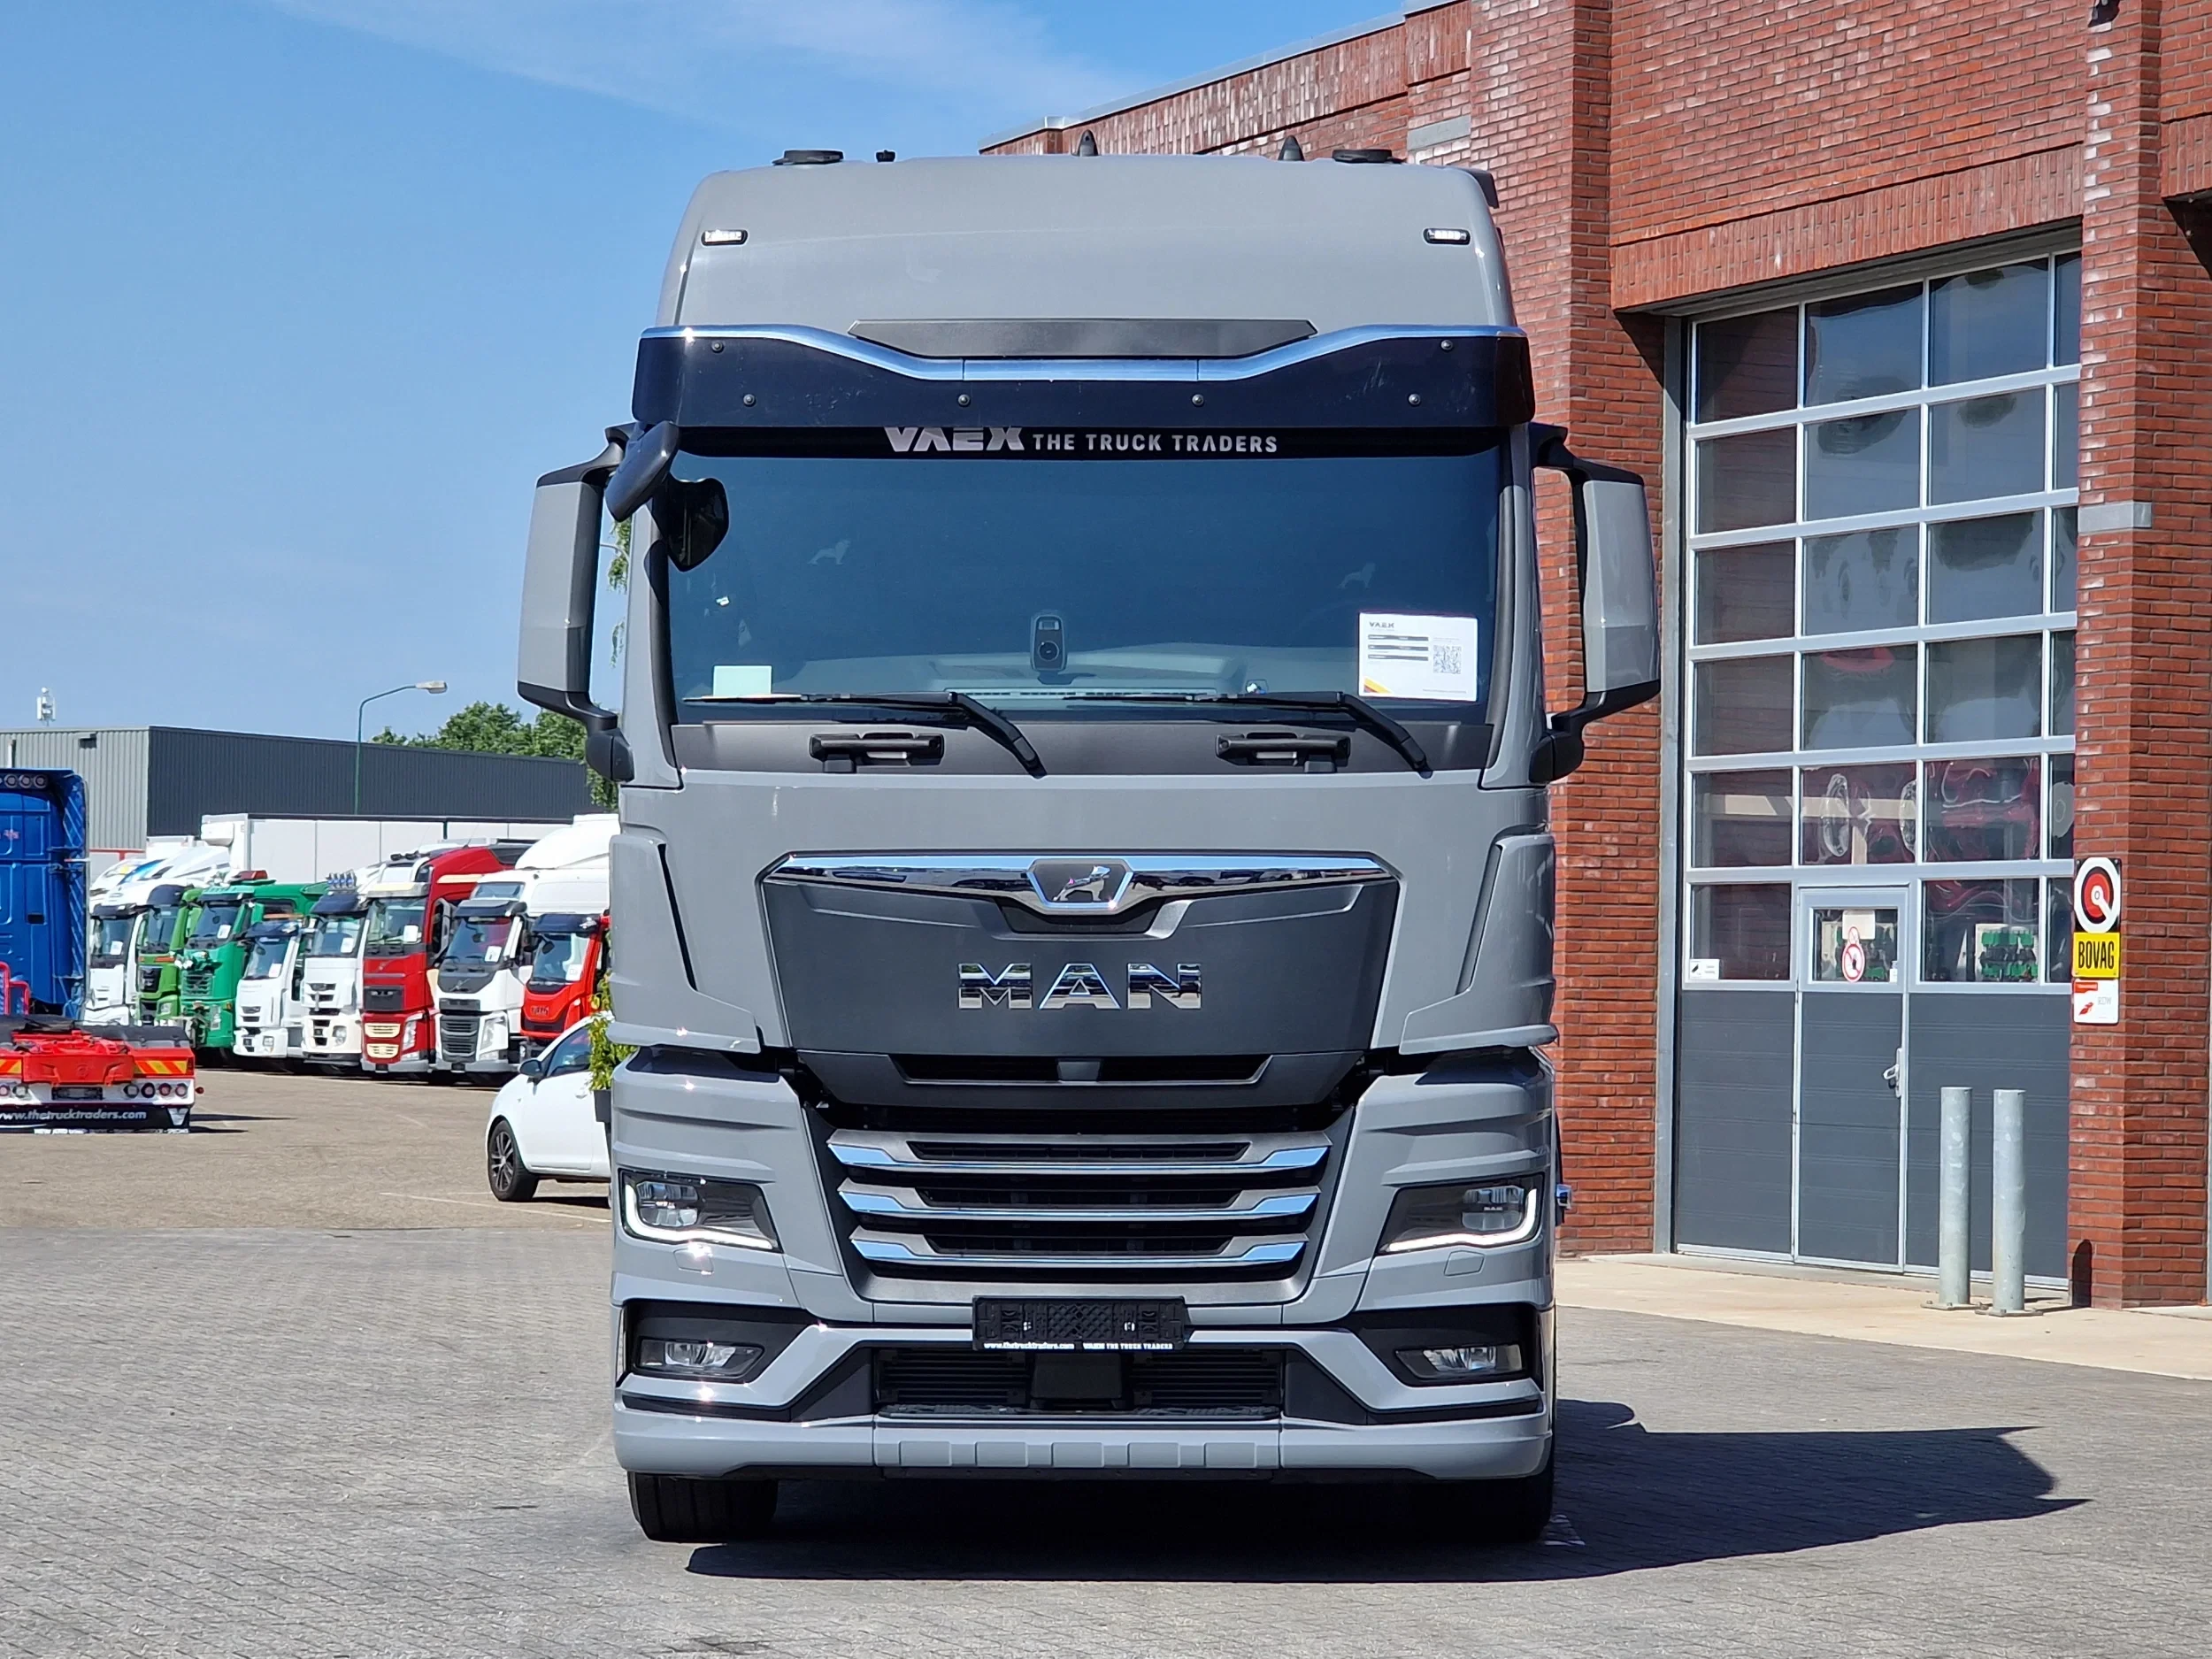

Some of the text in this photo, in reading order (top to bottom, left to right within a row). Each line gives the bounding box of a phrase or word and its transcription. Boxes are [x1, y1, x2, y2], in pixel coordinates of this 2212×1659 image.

[884, 426, 1278, 453] VAEX THE TRUCK TRADERS
[2078, 941, 2115, 970] BOVAG
[957, 962, 1202, 1010] MAN
[0, 1109, 147, 1120] ww.thetrucktraders.com
